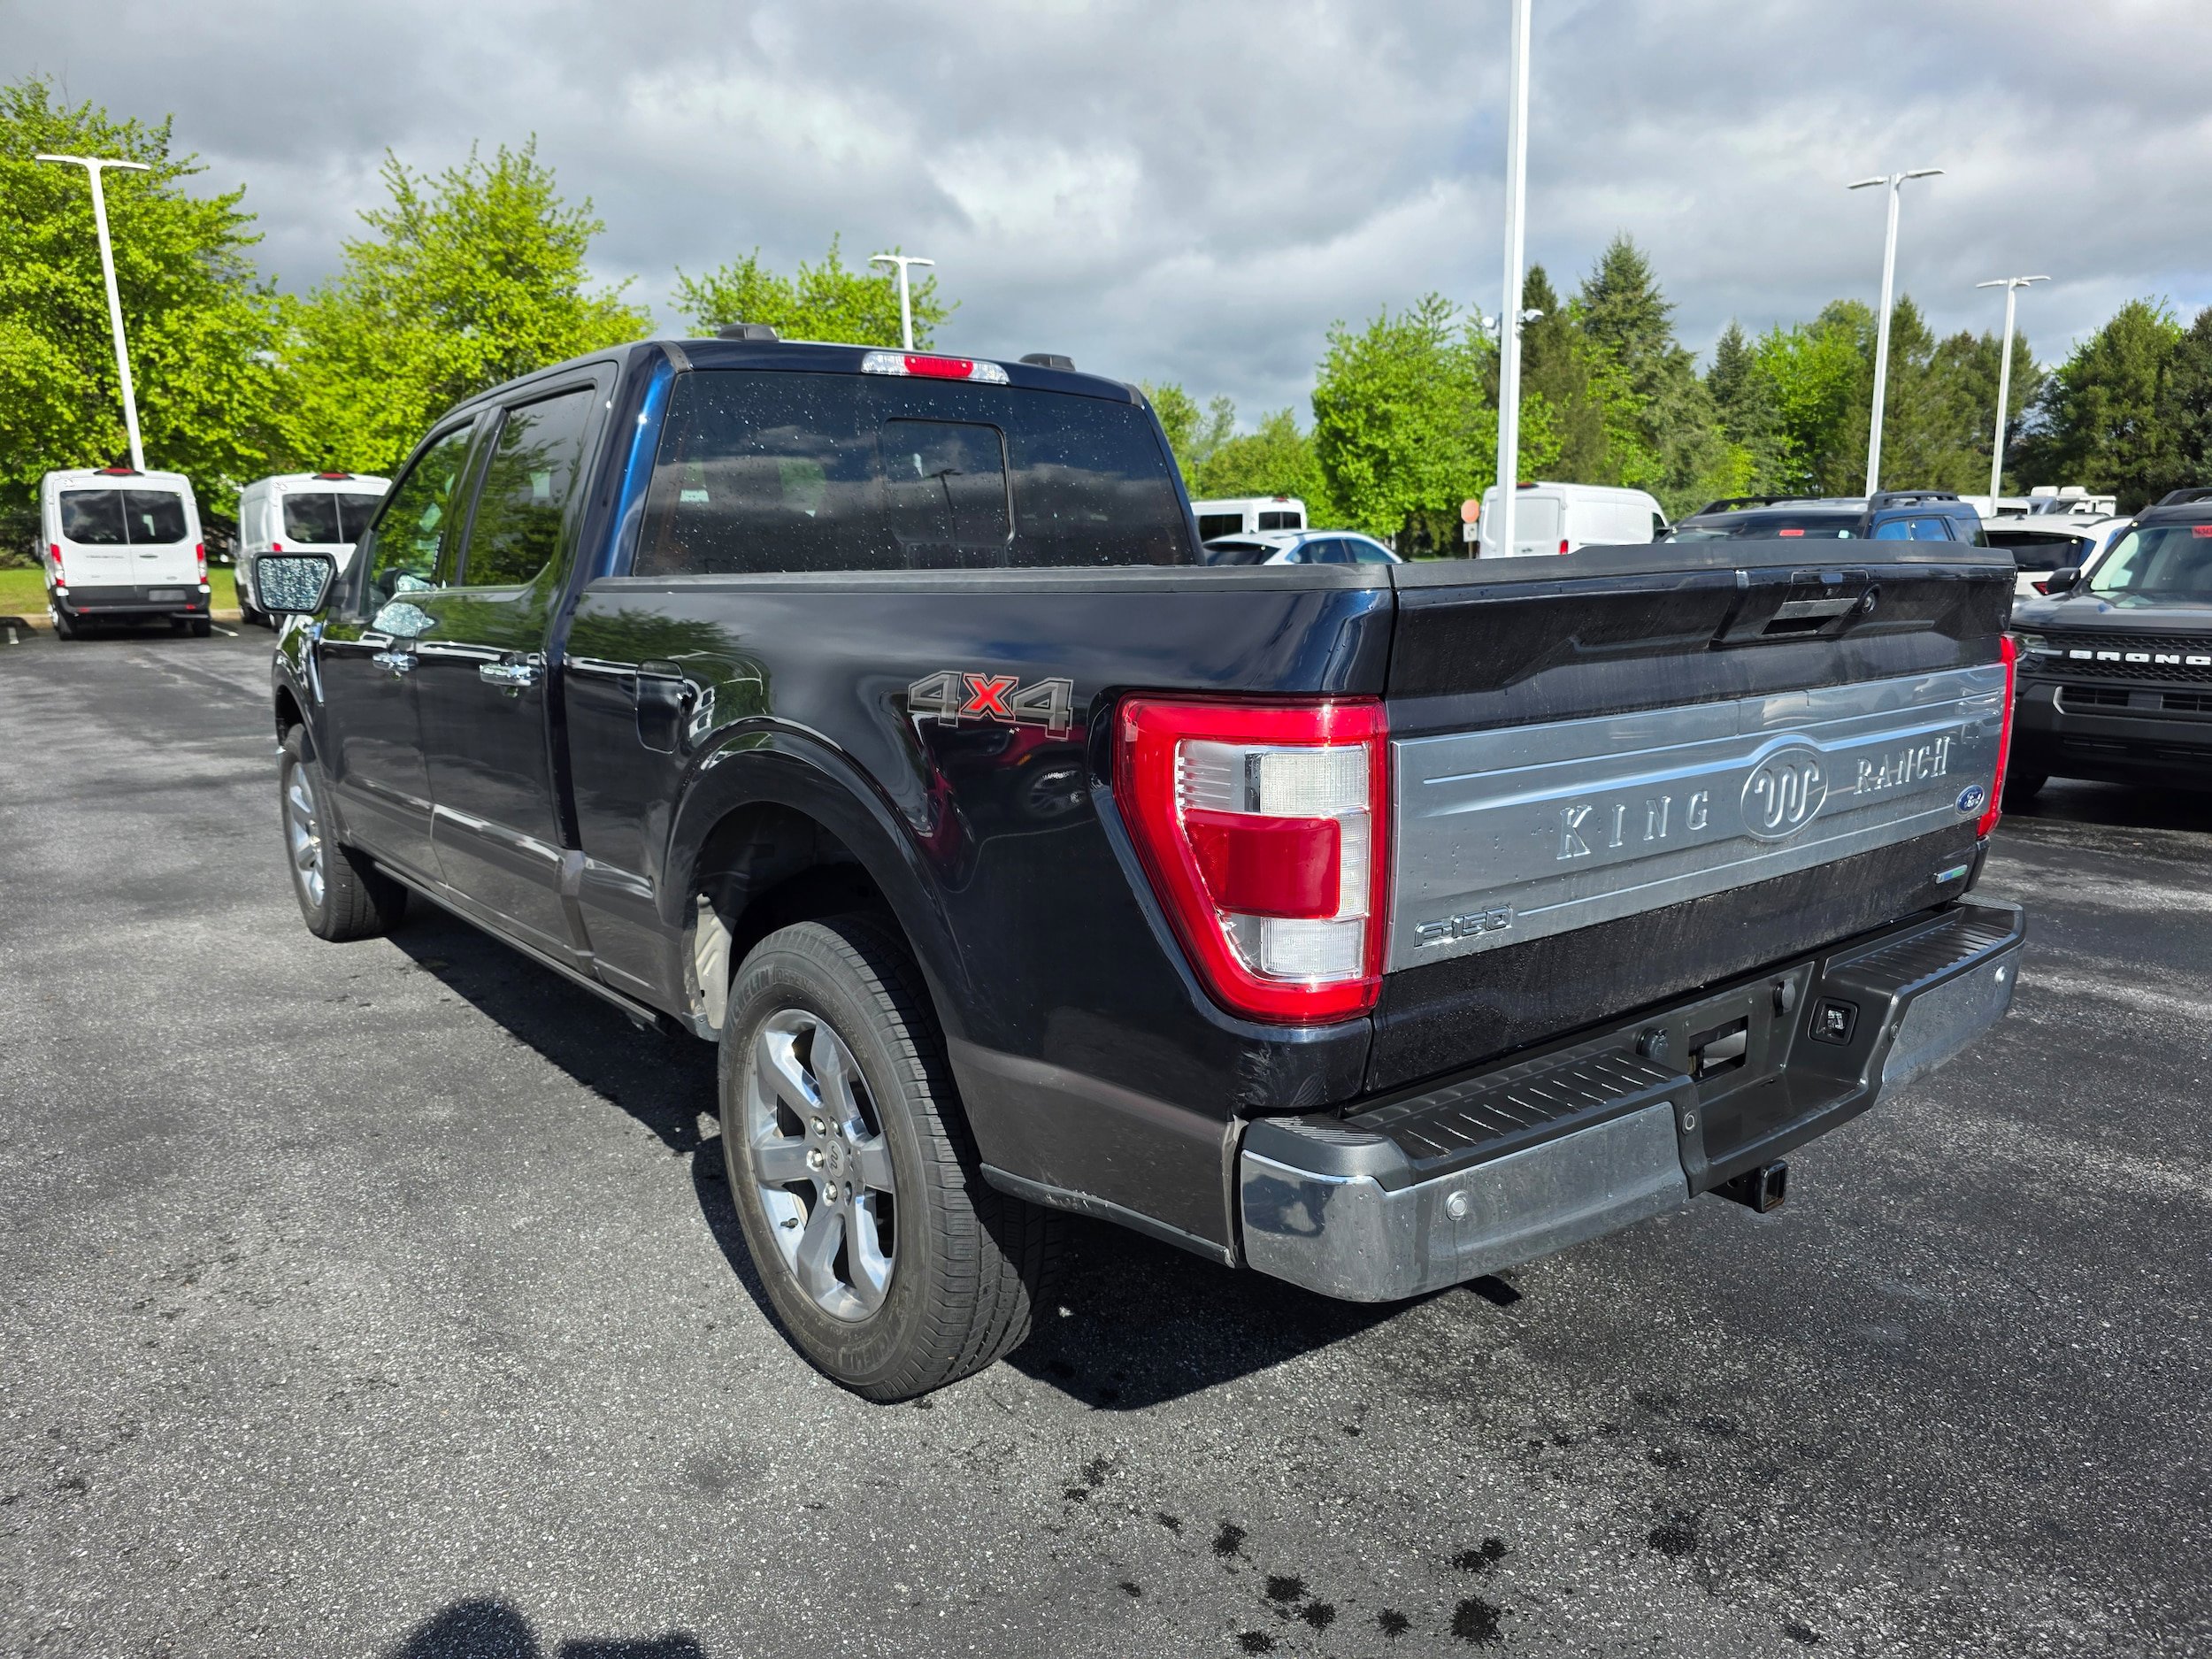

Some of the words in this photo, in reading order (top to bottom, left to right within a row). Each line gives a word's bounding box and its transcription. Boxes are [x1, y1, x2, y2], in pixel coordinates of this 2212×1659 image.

[1556, 790, 1709, 860] KING
[1854, 736, 1950, 795] RANCH
[1414, 905, 1513, 949] F-150
